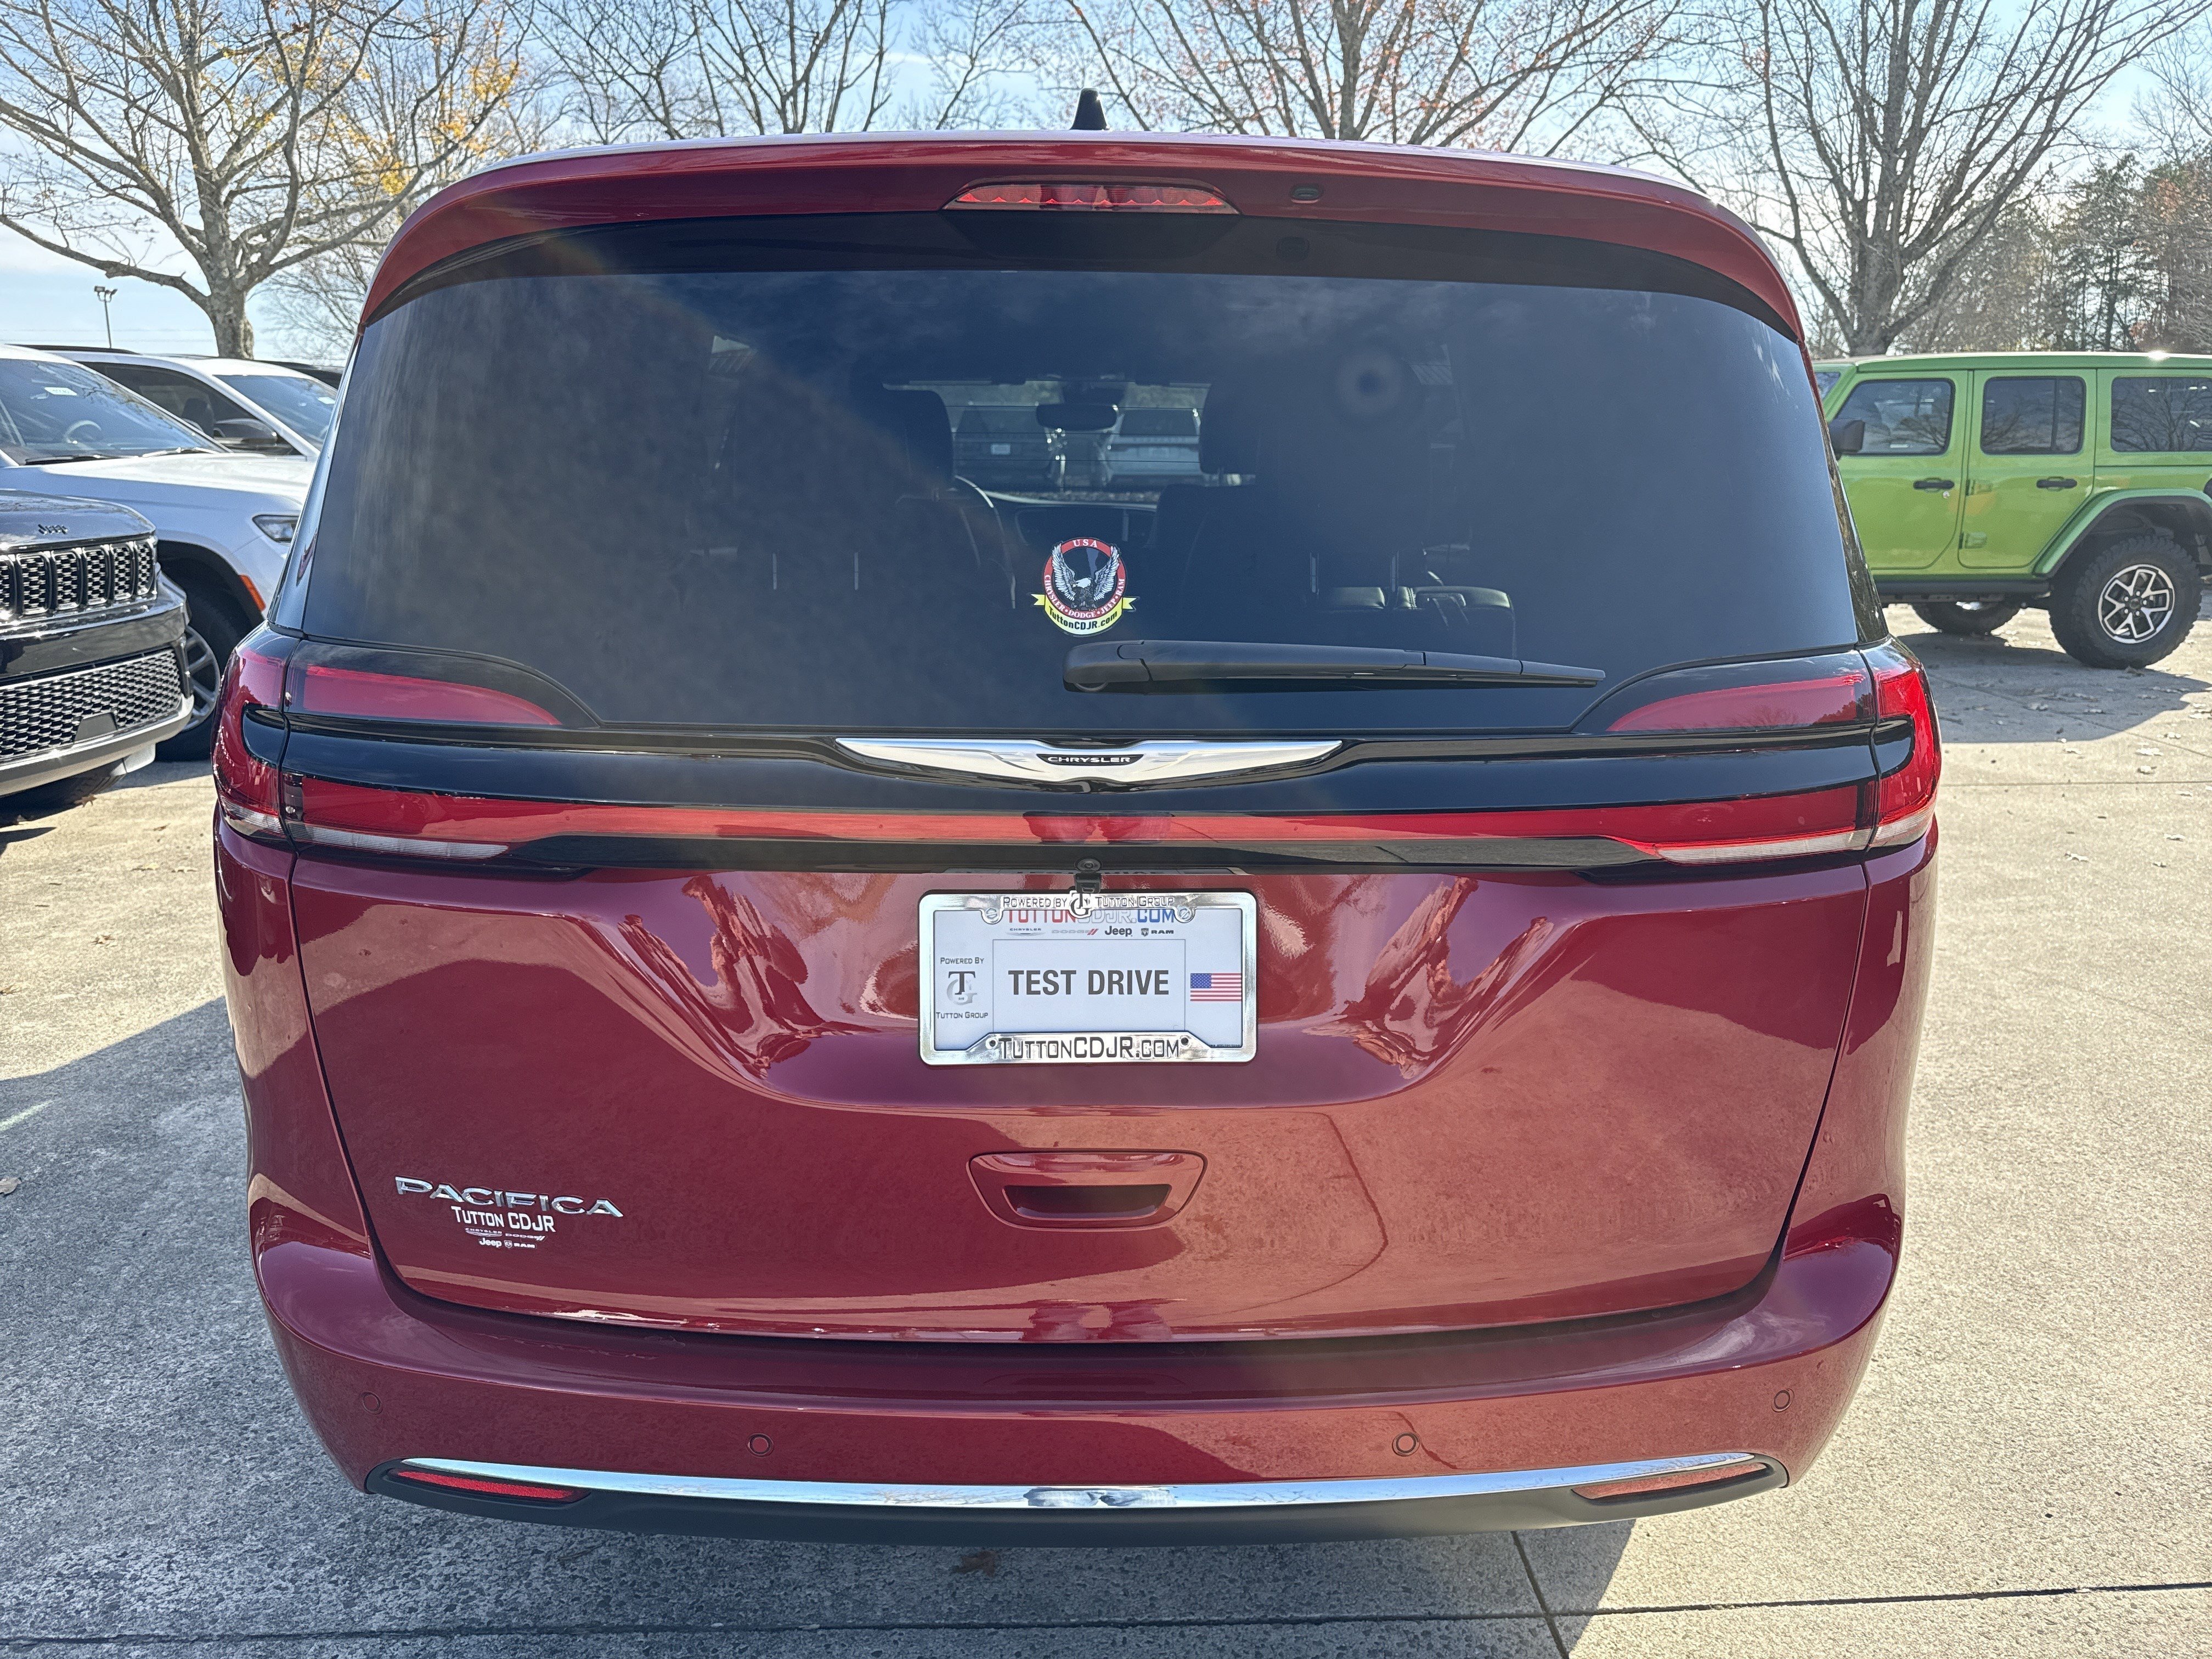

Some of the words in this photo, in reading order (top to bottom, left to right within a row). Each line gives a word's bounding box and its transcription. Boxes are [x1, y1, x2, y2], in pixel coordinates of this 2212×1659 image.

[1072, 539, 1098, 548] USA
[1044, 574, 1065, 612] CHRYSLER
[1068, 609, 1097, 618] DODGE
[1101, 601, 1116, 614] JEEP
[1116, 578, 1125, 596] RAM
[1048, 606, 1118, 630] TuttonCDJR.com
[1104, 926, 1132, 937] Jeep
[1008, 970, 1077, 995] TEST
[1088, 970, 1170, 995] DRIVE
[394, 1176, 624, 1217] PACIFICA
[507, 1212, 556, 1233] CDJR
[479, 1237, 502, 1248] Jeep
